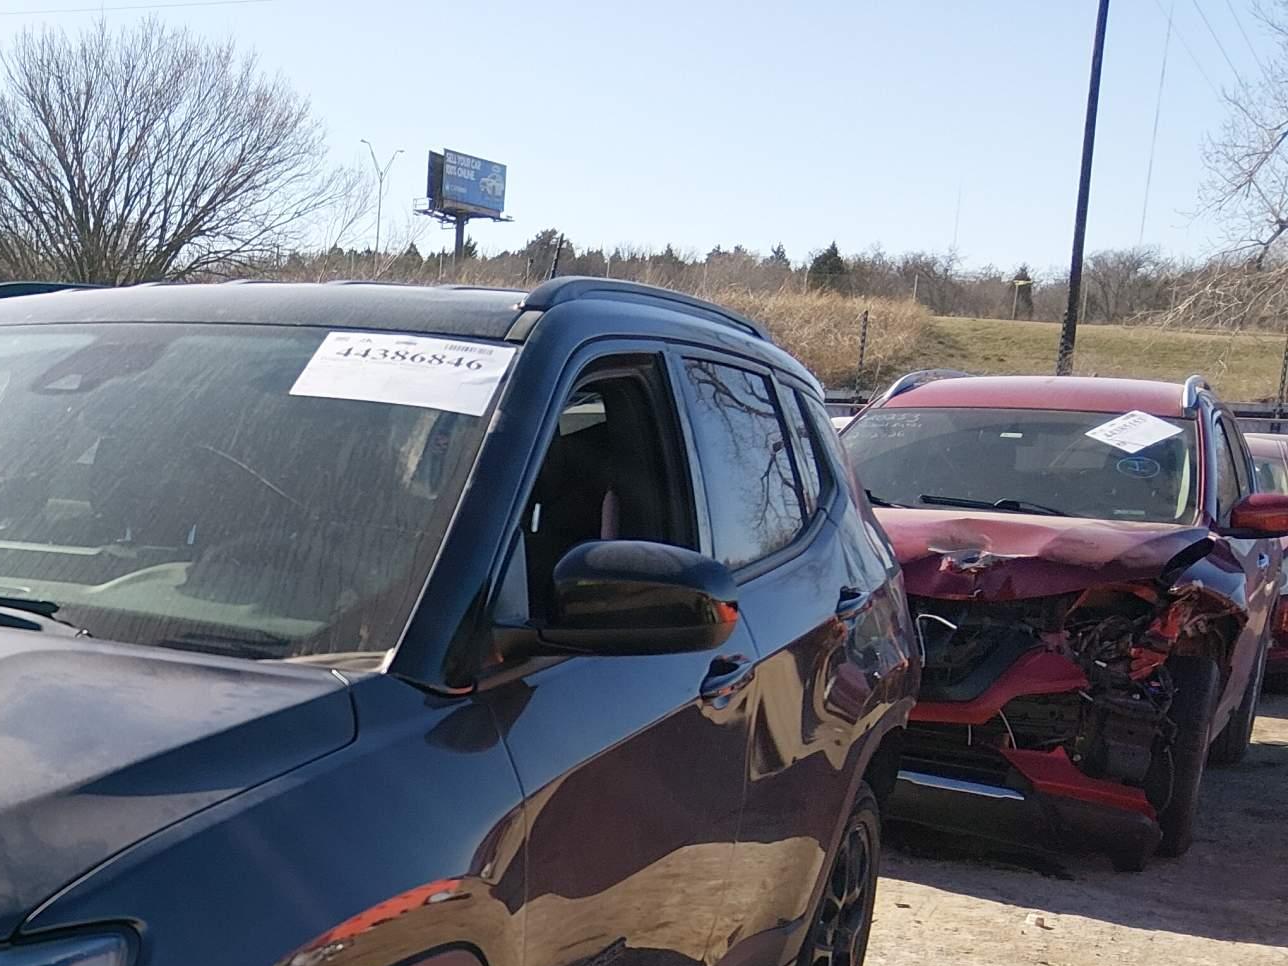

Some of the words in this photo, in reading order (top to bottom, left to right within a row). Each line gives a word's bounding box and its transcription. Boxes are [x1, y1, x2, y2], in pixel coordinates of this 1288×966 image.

[457, 155, 471, 168] YOUR
[471, 158, 481, 170] CAR
[335, 345, 483, 371] 44386846
